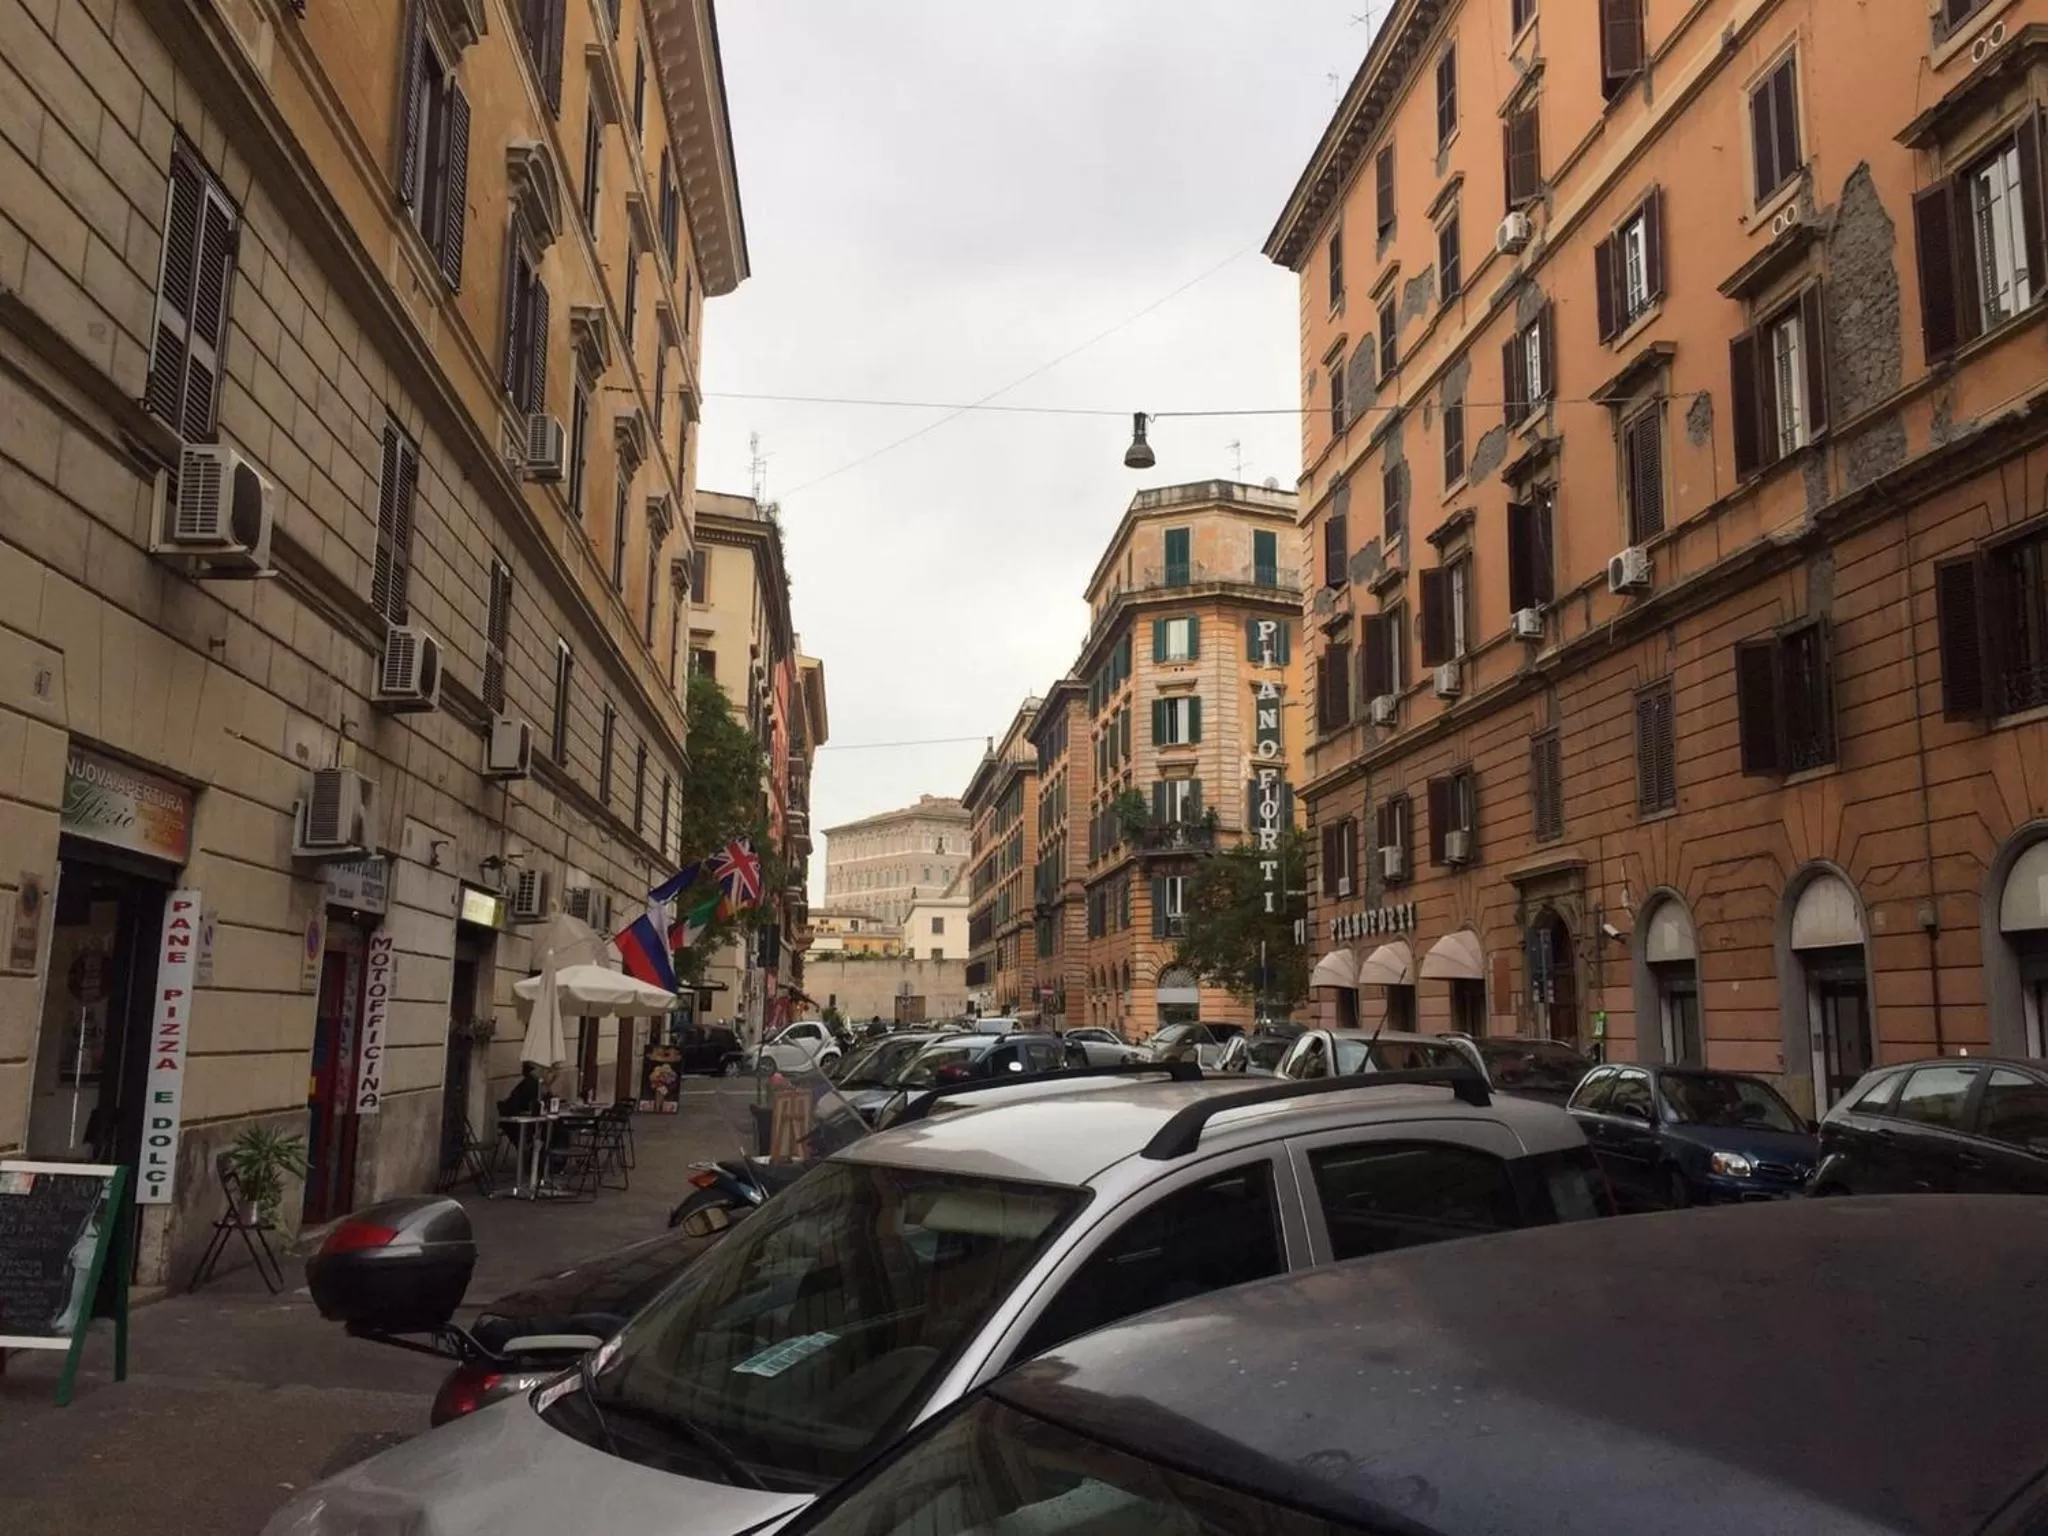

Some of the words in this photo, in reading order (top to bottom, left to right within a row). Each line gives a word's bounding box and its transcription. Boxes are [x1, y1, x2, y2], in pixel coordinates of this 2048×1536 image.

[1256, 619, 1280, 914] PIANOFORTI
[167, 900, 194, 964] PANE
[1329, 901, 1415, 942] PIANOFORTI
[155, 989, 183, 1071] PIZZA
[360, 937, 392, 1108] MOTOFFICINA
[154, 1090, 174, 1105] E
[149, 1117, 173, 1199] DOLCI
